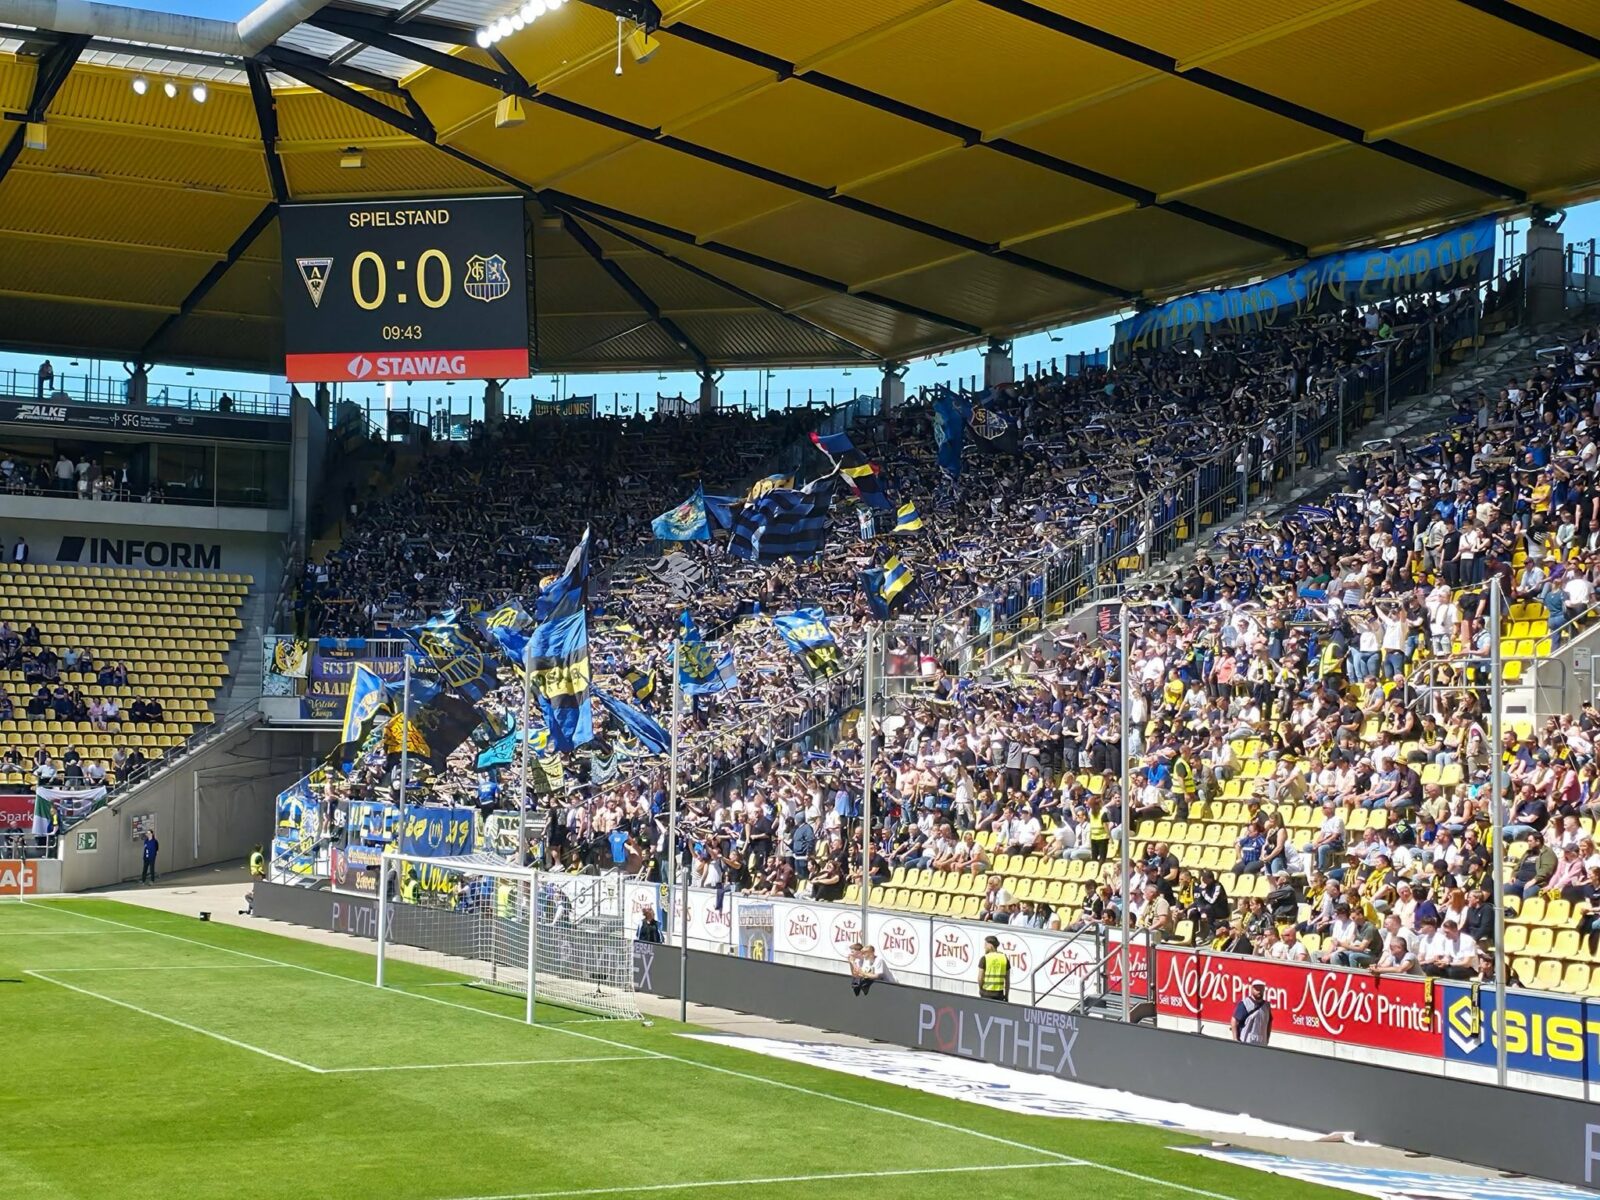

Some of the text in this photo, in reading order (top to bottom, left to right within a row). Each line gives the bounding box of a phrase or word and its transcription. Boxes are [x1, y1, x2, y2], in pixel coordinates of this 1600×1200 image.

[349, 209, 450, 227] SPIELSTAND
[351, 249, 452, 310] 0:0
[382, 325, 422, 340] 09:43
[376, 356, 466, 376] STAWAG
[121, 414, 139, 427] SFG
[89, 537, 221, 569] INFORM
[322, 661, 343, 675] FCS
[0, 811, 33, 823] Spark
[706, 908, 731, 926] ZENTIS
[789, 919, 818, 941] ZENTIS
[883, 932, 915, 955] ZENTIS
[935, 939, 969, 963] ZENTIS
[1159, 955, 1231, 1014] Nobis
[1158, 994, 1183, 1007] Seit 1858
[1291, 971, 1375, 1035] Nobis
[1023, 1007, 1079, 1031] UNIVERSAL
[1292, 1013, 1320, 1028] Seit 1858
[918, 1003, 1079, 1077] POLYTHEX
